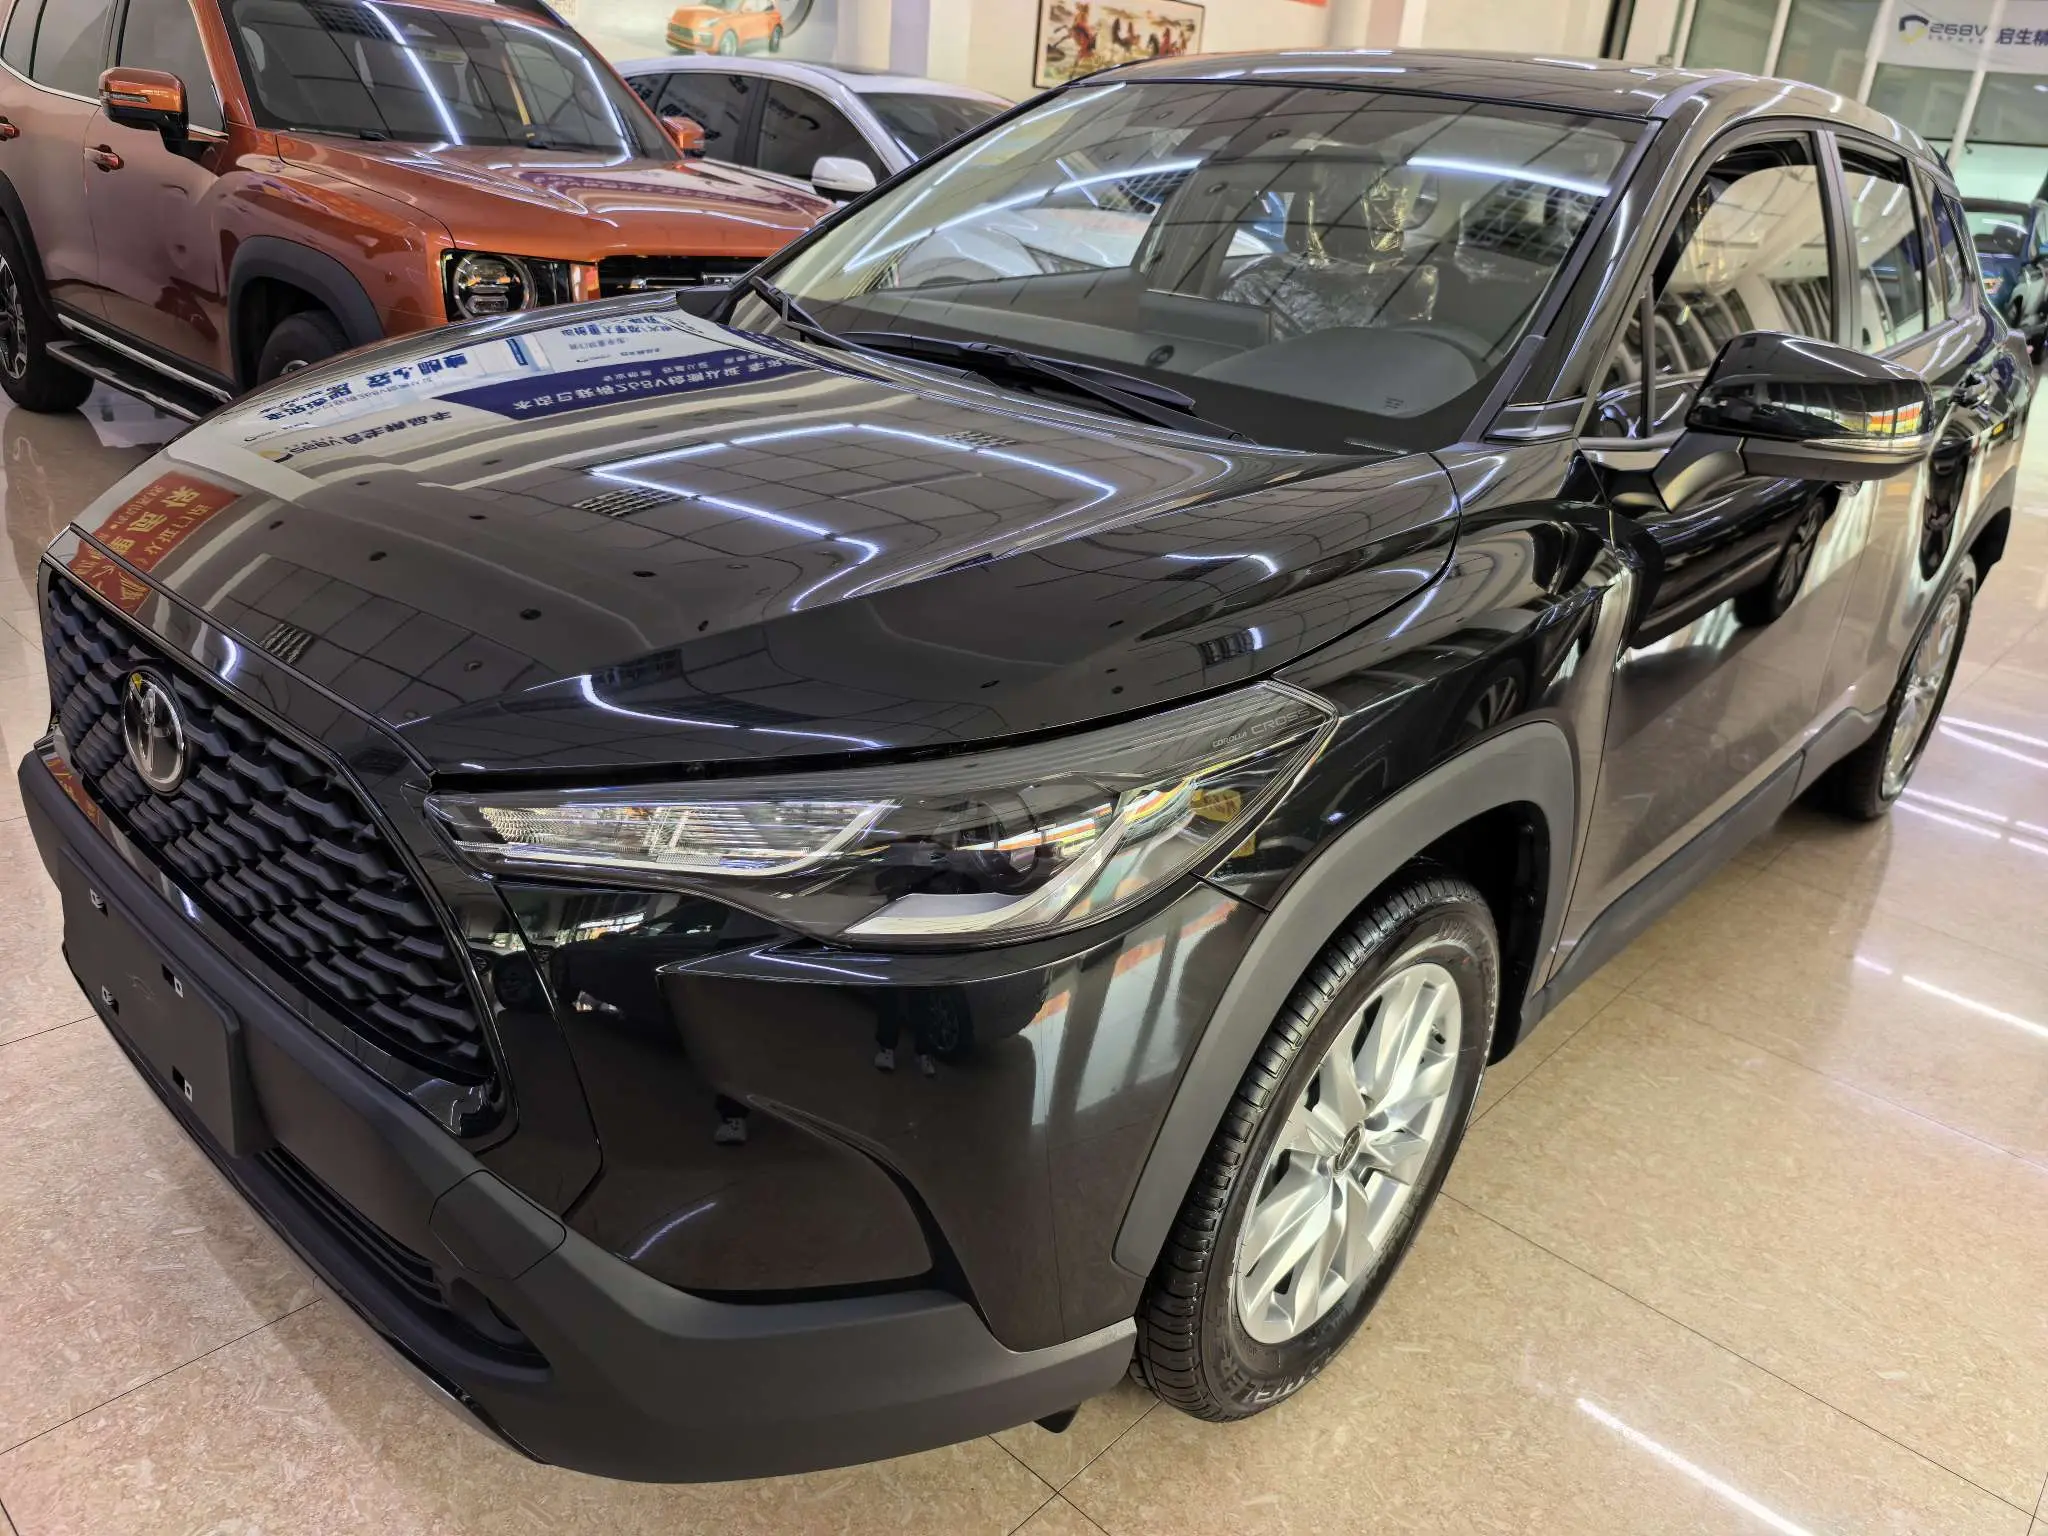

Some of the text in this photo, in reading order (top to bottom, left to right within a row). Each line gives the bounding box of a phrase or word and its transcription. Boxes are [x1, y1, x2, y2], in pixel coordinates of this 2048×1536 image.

[1929, 23, 1988, 36] 268V
[1212, 709, 1311, 748] COROLLA CROSS
